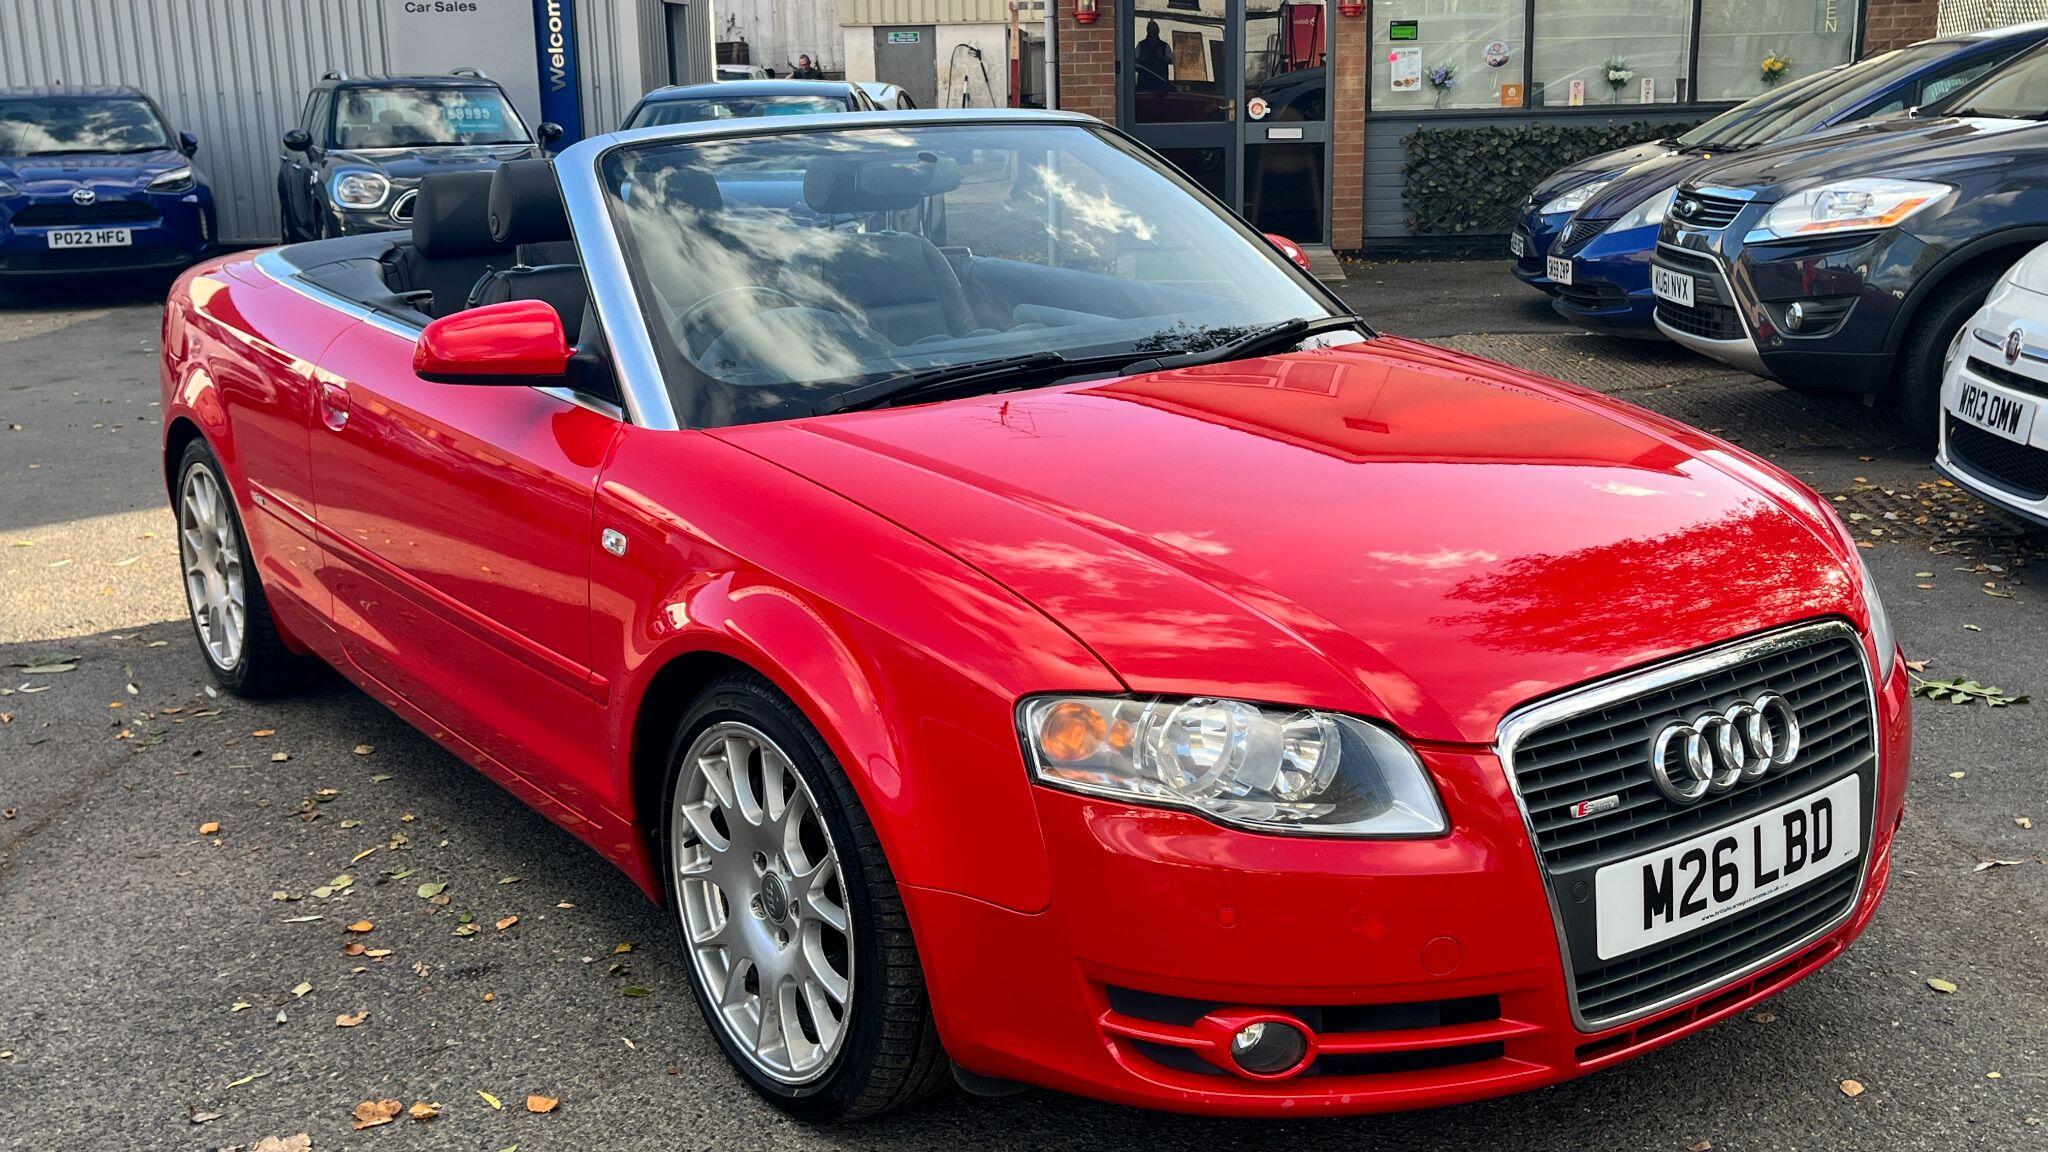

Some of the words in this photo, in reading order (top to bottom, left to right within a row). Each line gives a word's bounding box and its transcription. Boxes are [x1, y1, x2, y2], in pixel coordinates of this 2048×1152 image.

[404, 2, 431, 13] Car
[434, 1, 477, 12] Sales
[96, 230, 125, 244] HFG
[1671, 274, 1689, 300] NVX
[1959, 382, 1988, 422] WR13
[1643, 836, 1739, 931] M26
[1753, 797, 1833, 890] LBD
